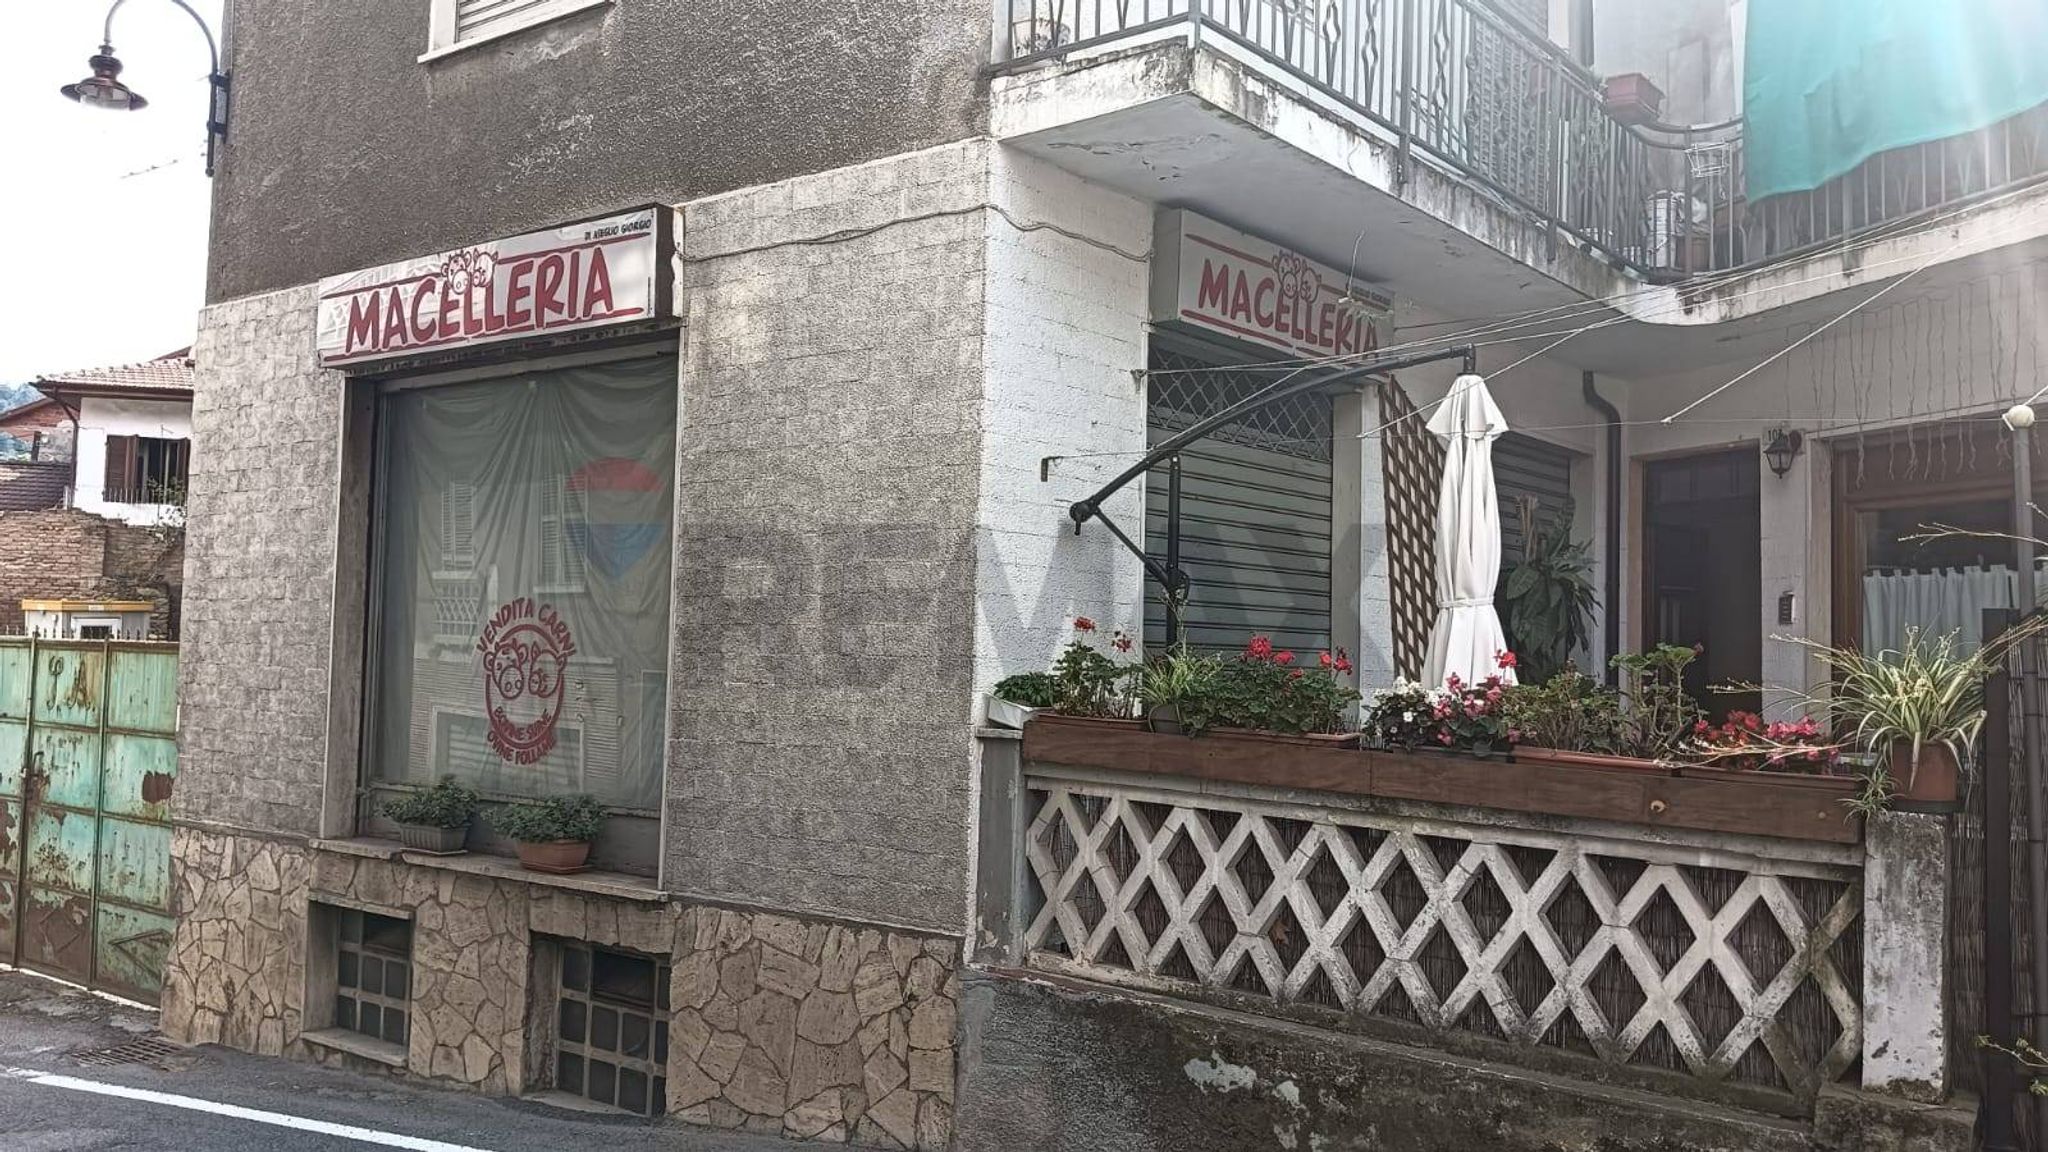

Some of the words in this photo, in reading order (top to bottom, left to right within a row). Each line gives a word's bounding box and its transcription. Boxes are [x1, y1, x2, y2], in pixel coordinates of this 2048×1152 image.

[621, 219, 652, 234] GIORGIO
[345, 247, 614, 353] MACELLERIA
[1198, 258, 1379, 361] MACELLERIA
[477, 598, 534, 652] VENDITA
[539, 603, 577, 657] CARNI
